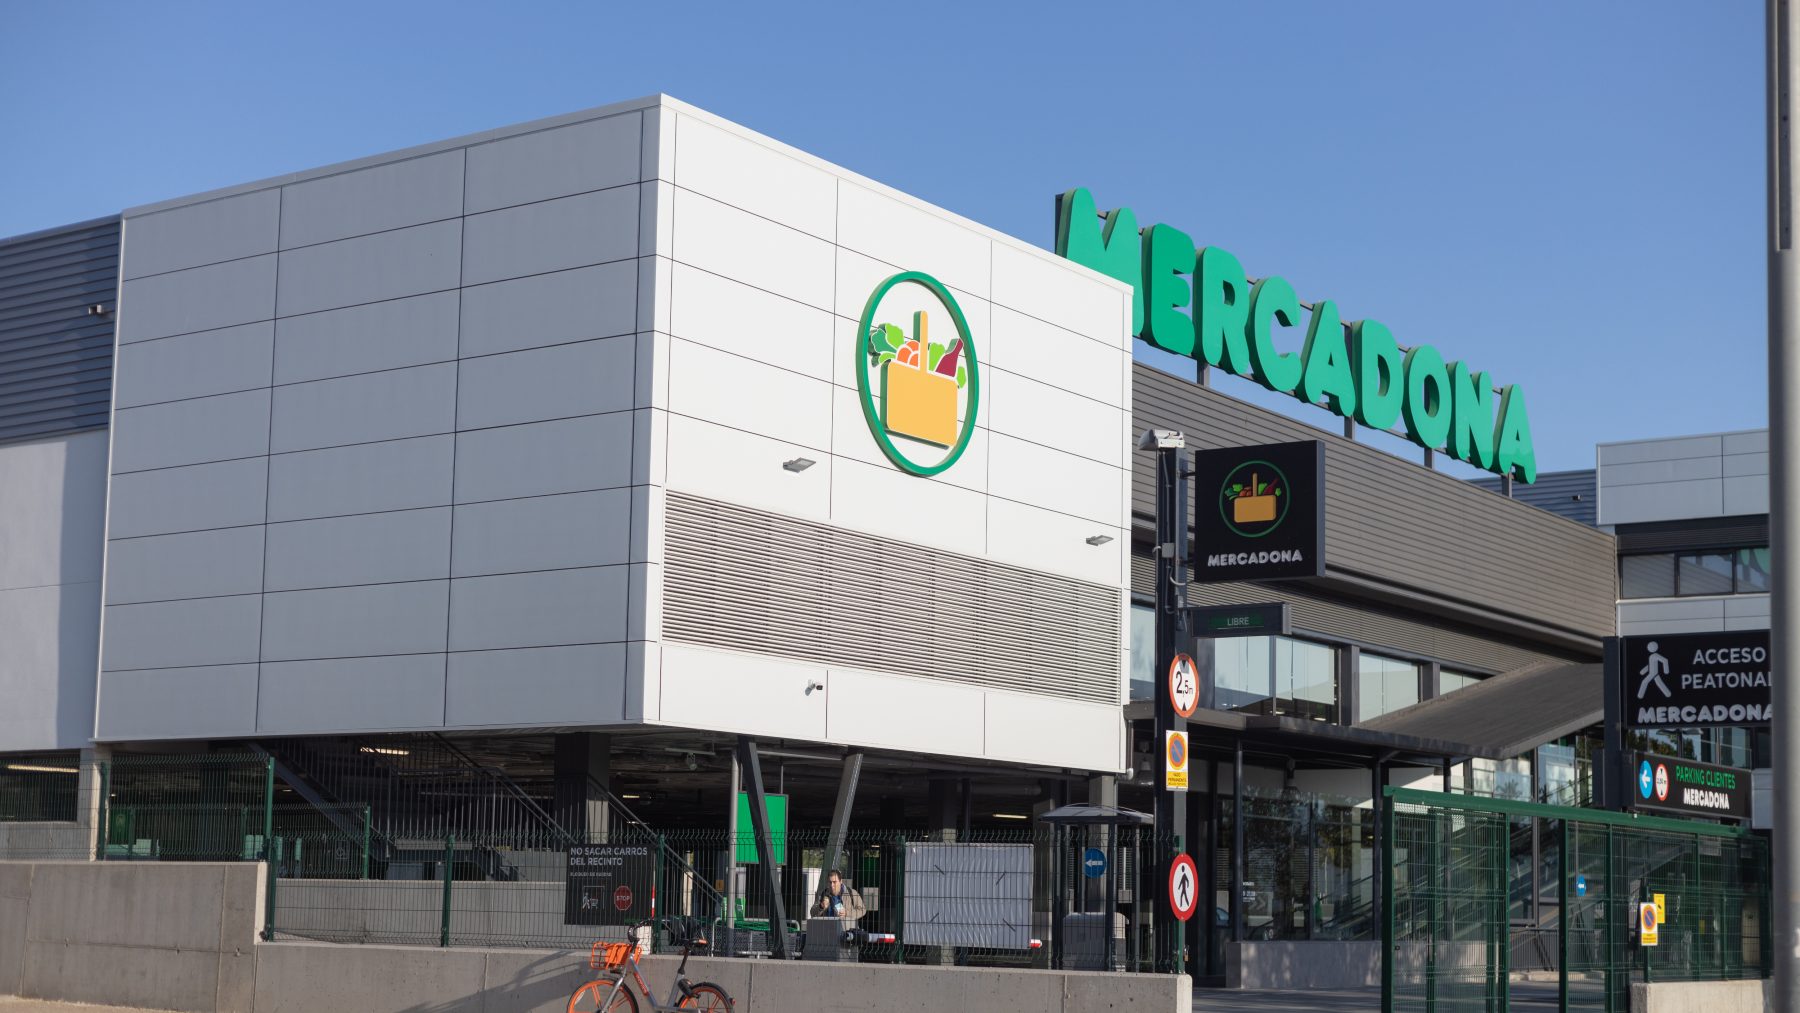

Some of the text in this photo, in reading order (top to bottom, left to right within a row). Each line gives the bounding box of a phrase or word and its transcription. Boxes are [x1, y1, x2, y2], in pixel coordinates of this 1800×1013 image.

[1056, 187, 1537, 485] MERCADONA
[1207, 550, 1303, 568] MERCADONA
[1227, 617, 1250, 626] LIBRE
[1693, 647, 1766, 665] ACCESO
[1637, 704, 1773, 724] MERCADONA
[1675, 765, 1736, 790] PARKING CLIENTES
[1683, 787, 1730, 810] MERCADONA
[570, 847, 648, 856] NO SACAR CARROS
[570, 858, 623, 866] DEL RECINTO
